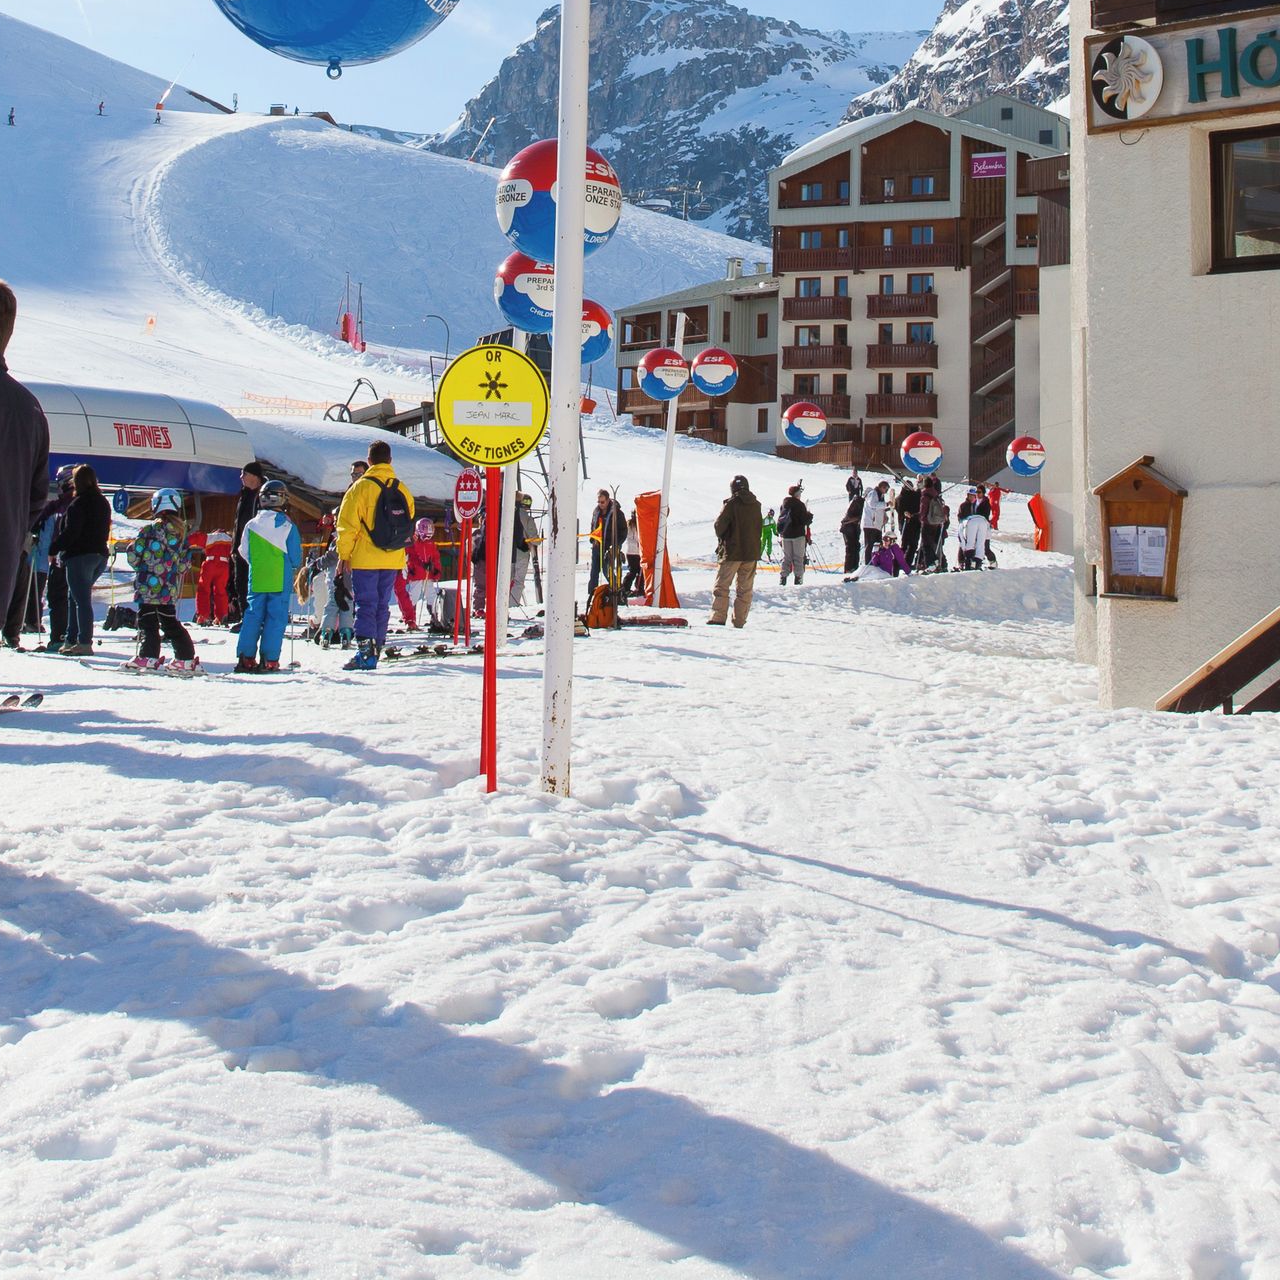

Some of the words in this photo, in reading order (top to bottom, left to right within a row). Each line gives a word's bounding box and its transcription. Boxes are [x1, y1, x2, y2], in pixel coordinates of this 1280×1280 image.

[485, 350, 502, 362] OR
[466, 410, 490, 420] JEAN
[494, 411, 521, 421] MARC
[113, 422, 173, 449] TIGNES
[460, 436, 481, 456] ESF
[484, 437, 526, 459] TIGNES
